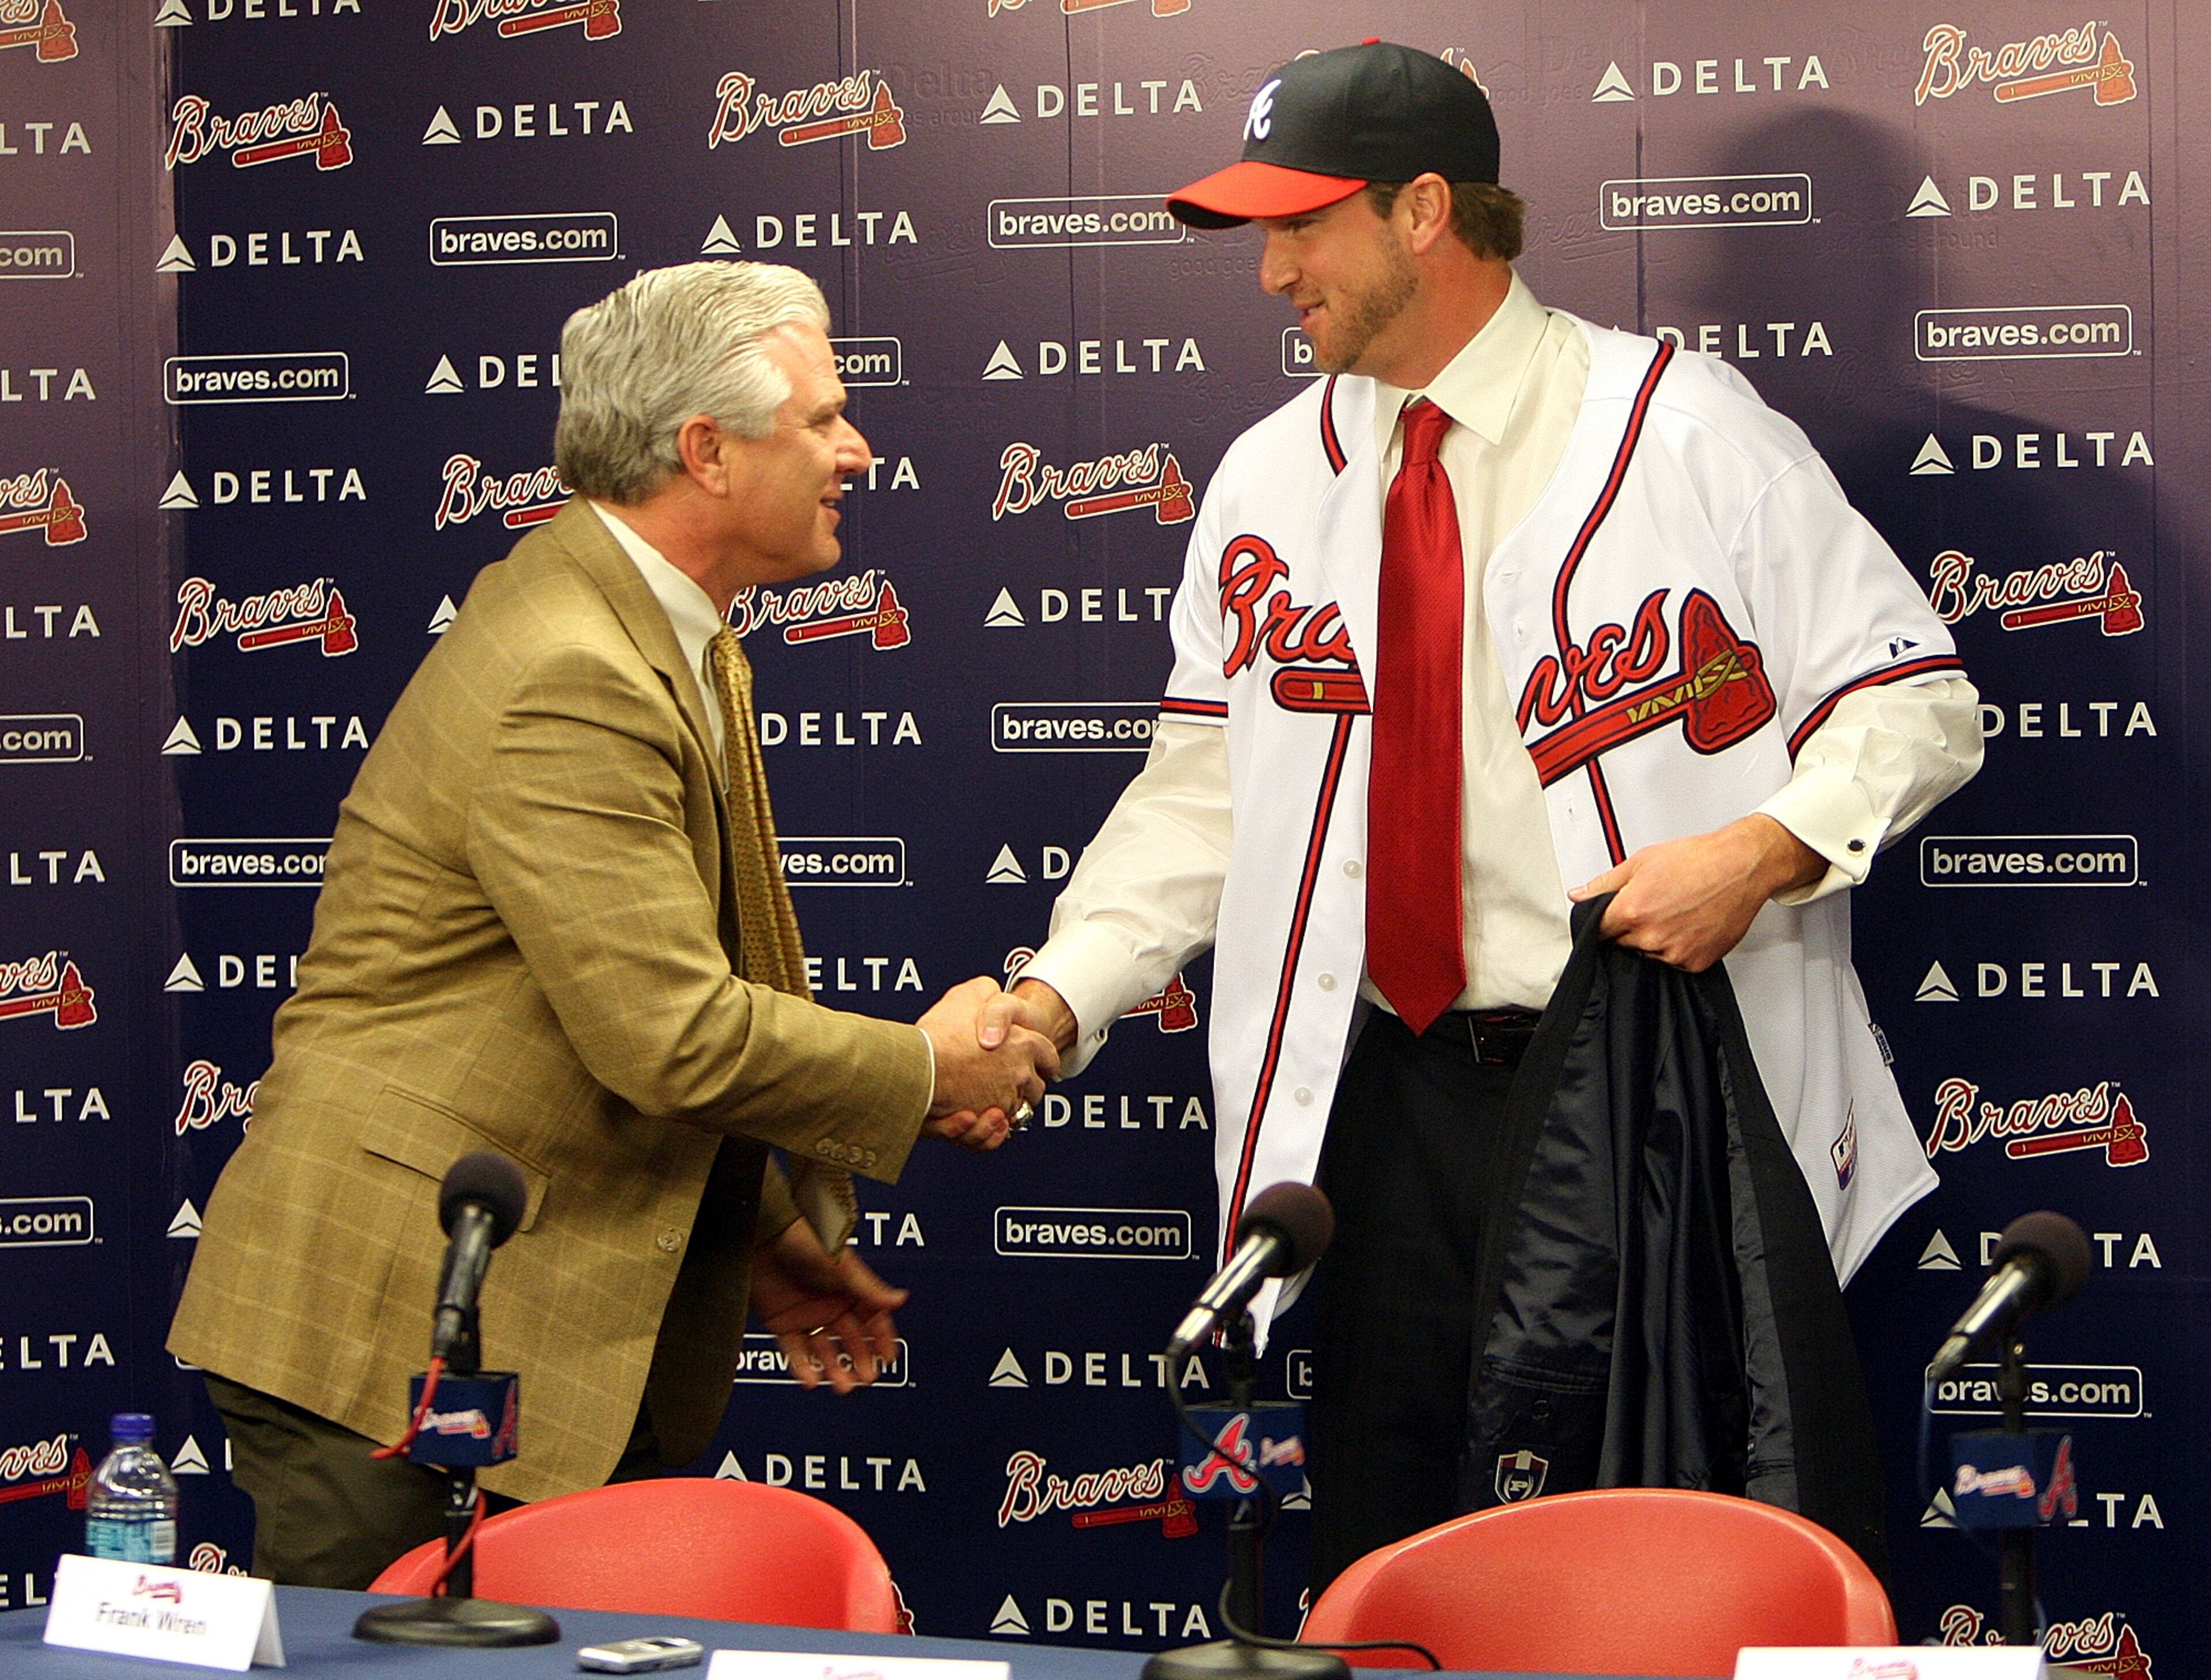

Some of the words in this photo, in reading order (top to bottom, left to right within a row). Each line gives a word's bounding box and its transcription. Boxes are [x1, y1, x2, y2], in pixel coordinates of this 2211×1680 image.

[1653, 55, 1829, 96] DELTA
[1914, 20, 2096, 107] Braves
[708, 71, 870, 149] Braves
[1038, 79, 1202, 118] DELTA
[0, 122, 92, 154] LTA
[165, 92, 320, 170] Braves
[477, 101, 633, 139] DELTA
[1612, 191, 1799, 218] braves.com
[1969, 171, 2151, 211] DELTA
[441, 229, 607, 253] braves.com
[757, 211, 918, 248] DELTA
[1000, 211, 1175, 235] braves.com
[211, 230, 364, 267] DELTA
[1657, 322, 1833, 360] DELTA
[1928, 321, 2119, 348] braves.com
[1040, 338, 1205, 374] DELTA
[0, 368, 97, 401] LTA
[176, 367, 338, 389] braves.com
[1973, 431, 2154, 469] DELTA
[214, 468, 366, 504] DELTA
[435, 453, 575, 530] Brav
[992, 442, 1158, 522] Braves
[1041, 588, 1171, 622] DELT
[1929, 550, 2104, 624] Braves
[6, 605, 100, 637] LTA
[170, 577, 325, 653] Braves
[216, 716, 368, 750] DELTA
[761, 712, 922, 746] DELTA
[1979, 702, 2157, 740] DELTA
[10, 850, 106, 884] LTA
[1933, 848, 2126, 874] braves.com
[804, 957, 924, 991] ELTA
[1978, 963, 2160, 997] DELTA
[15, 1088, 110, 1122] LTA
[1044, 1094, 1209, 1130] DELTA
[1927, 1077, 2109, 1159] Braves
[1006, 1218, 1180, 1246] braves.com
[1981, 1232, 2161, 1268] DTA
[0, 1333, 116, 1369] LTA
[1046, 1351, 1209, 1389] DELTA
[766, 1454, 926, 1492] DELTA
[998, 1450, 1164, 1528] Braves
[1047, 1598, 1211, 1639] DELTA
